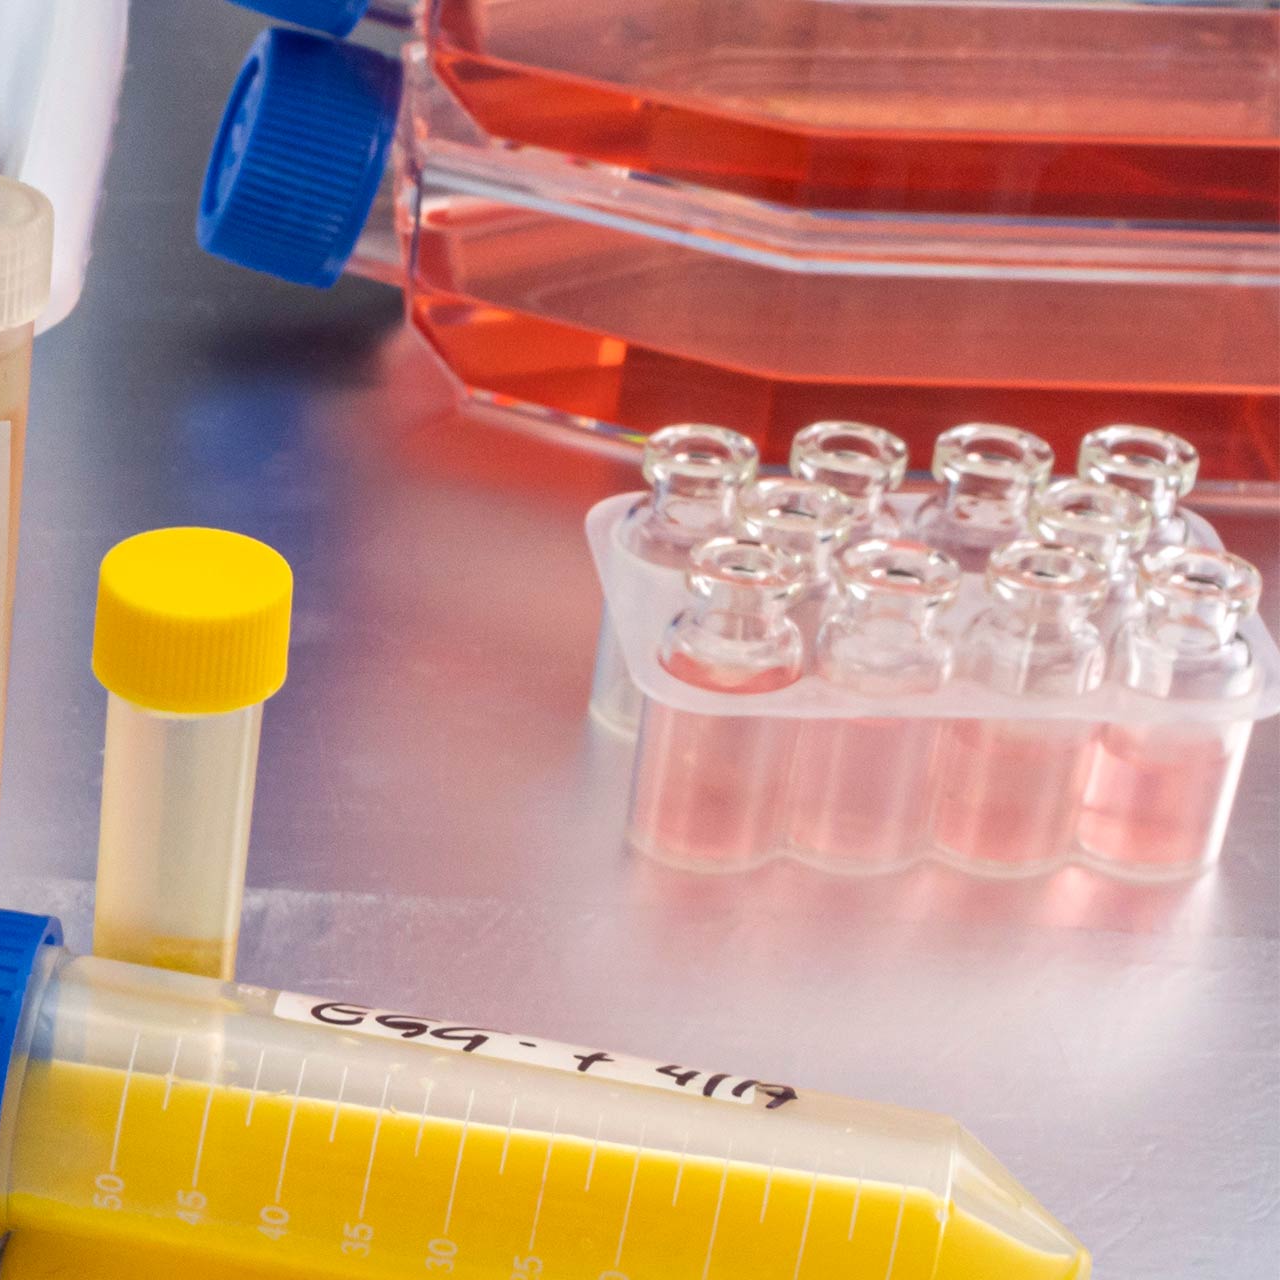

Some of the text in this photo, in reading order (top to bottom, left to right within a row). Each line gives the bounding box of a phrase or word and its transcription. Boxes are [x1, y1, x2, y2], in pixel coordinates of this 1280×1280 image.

[92, 1173, 124, 1211] 50
[176, 1189, 207, 1225] 45
[257, 1206, 290, 1240] 40
[341, 1223, 373, 1257] 35
[425, 1239, 458, 1274] 30
